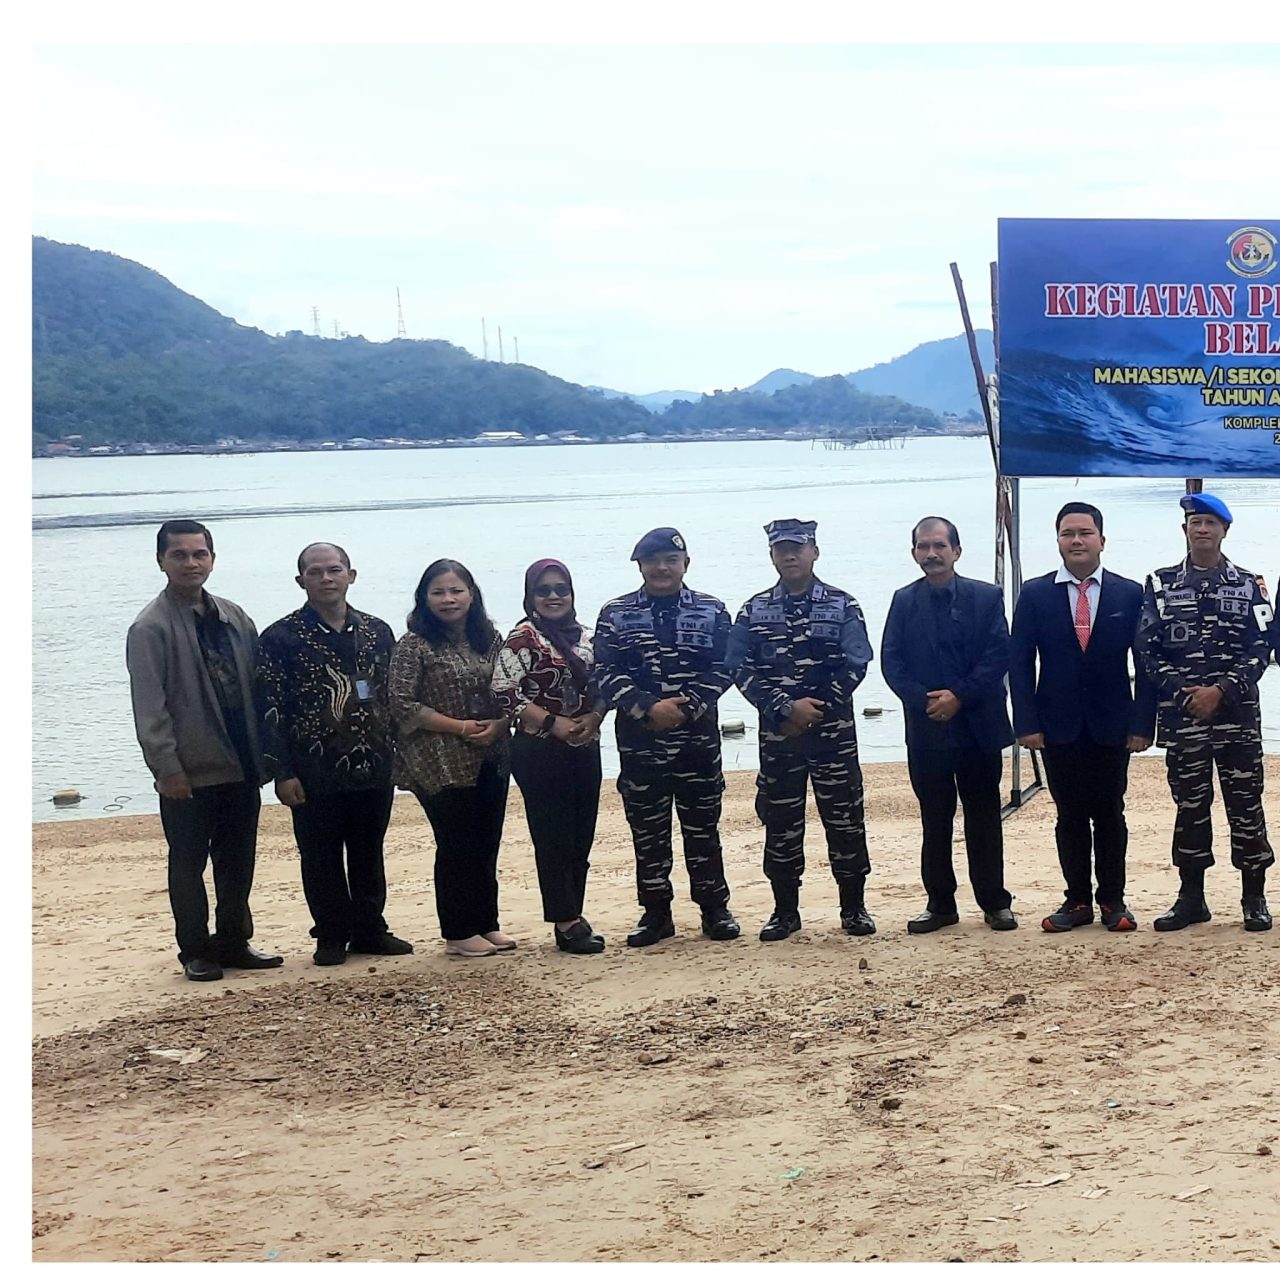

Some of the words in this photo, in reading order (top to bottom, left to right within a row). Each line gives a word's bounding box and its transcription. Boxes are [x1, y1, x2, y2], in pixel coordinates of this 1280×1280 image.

[1045, 284, 1236, 318] KEGIATAN
[1094, 366, 1225, 387] MAHASISWA/I
[1202, 388, 1266, 406] TAHUN
[1222, 589, 1236, 597] TNI
[1238, 589, 1249, 598] AL
[1253, 603, 1274, 632] P
